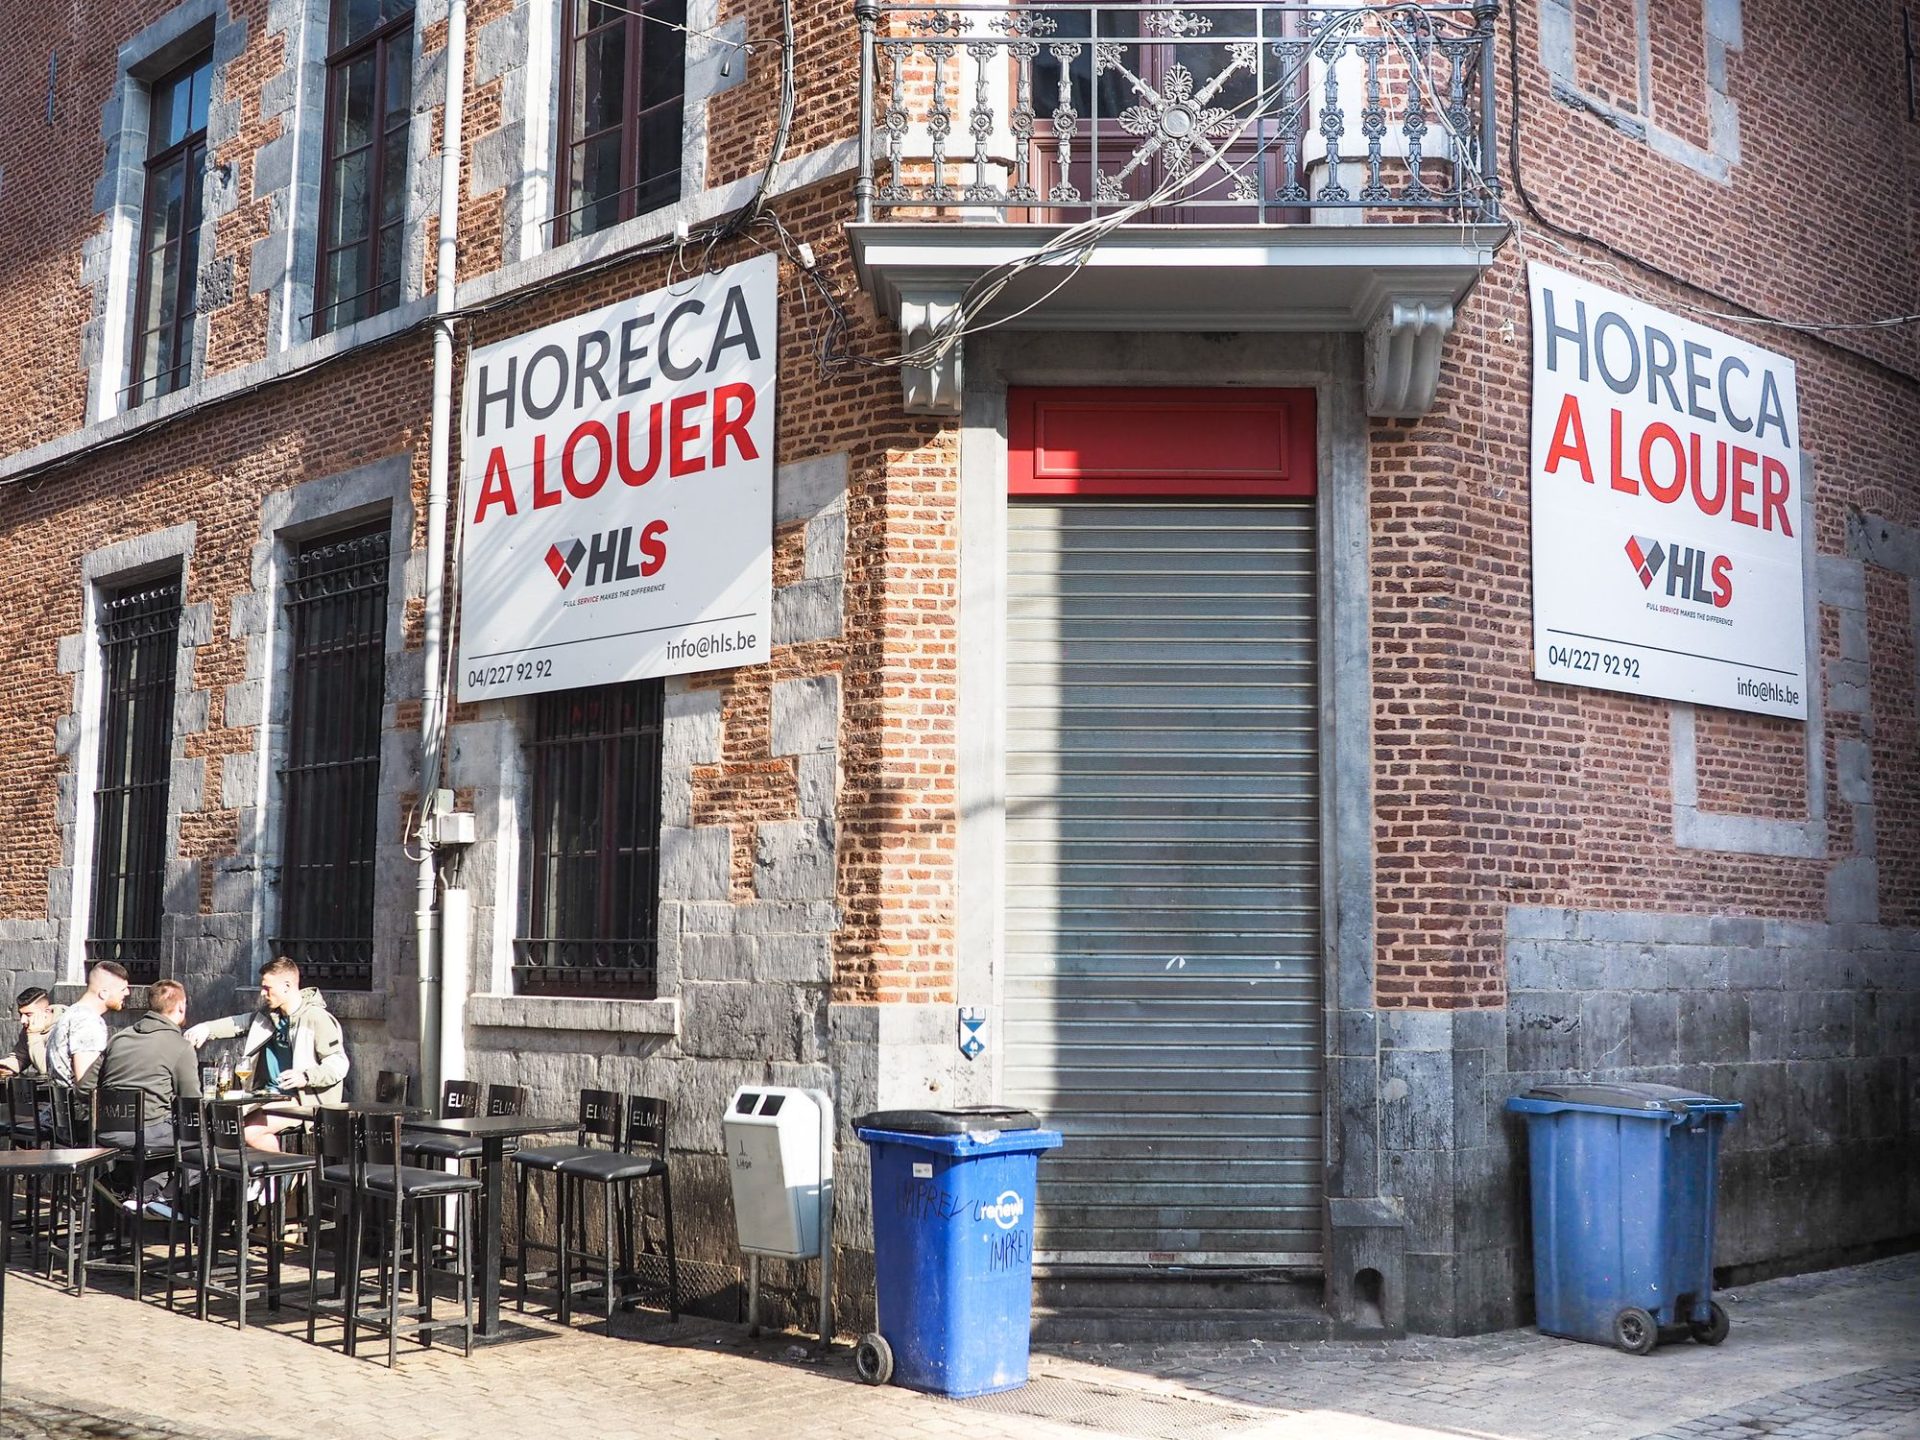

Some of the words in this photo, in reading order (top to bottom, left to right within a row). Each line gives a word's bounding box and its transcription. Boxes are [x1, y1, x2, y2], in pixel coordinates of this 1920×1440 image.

[477, 285, 761, 437] HORECA
[1543, 287, 1791, 448] HORECA
[473, 446, 518, 524] A
[533, 382, 760, 510] LOUER
[1544, 393, 1595, 484] A
[1611, 408, 1794, 538] LOUER
[585, 519, 669, 586] HLS
[1666, 544, 1734, 609] HLS
[577, 595, 599, 605] SERVICE
[600, 592, 618, 601] MAKES
[620, 590, 629, 598] THE
[630, 583, 666, 596] DIFFERENCE
[1646, 602, 1659, 611] FULL
[1659, 605, 1679, 616] SERVICE
[1680, 609, 1696, 619] MAKES
[1696, 612, 1705, 621] THE
[1705, 614, 1734, 627] DIFFERENCE
[666, 630, 756, 660] info@hls.be
[1548, 645, 1600, 671] 04/227
[1603, 654, 1620, 675] 92
[1623, 657, 1640, 678] 92
[468, 665, 513, 688] 04/227
[516, 662, 532, 681] 92
[536, 659, 552, 678] 92
[1737, 676, 1799, 705] info@hls.be
